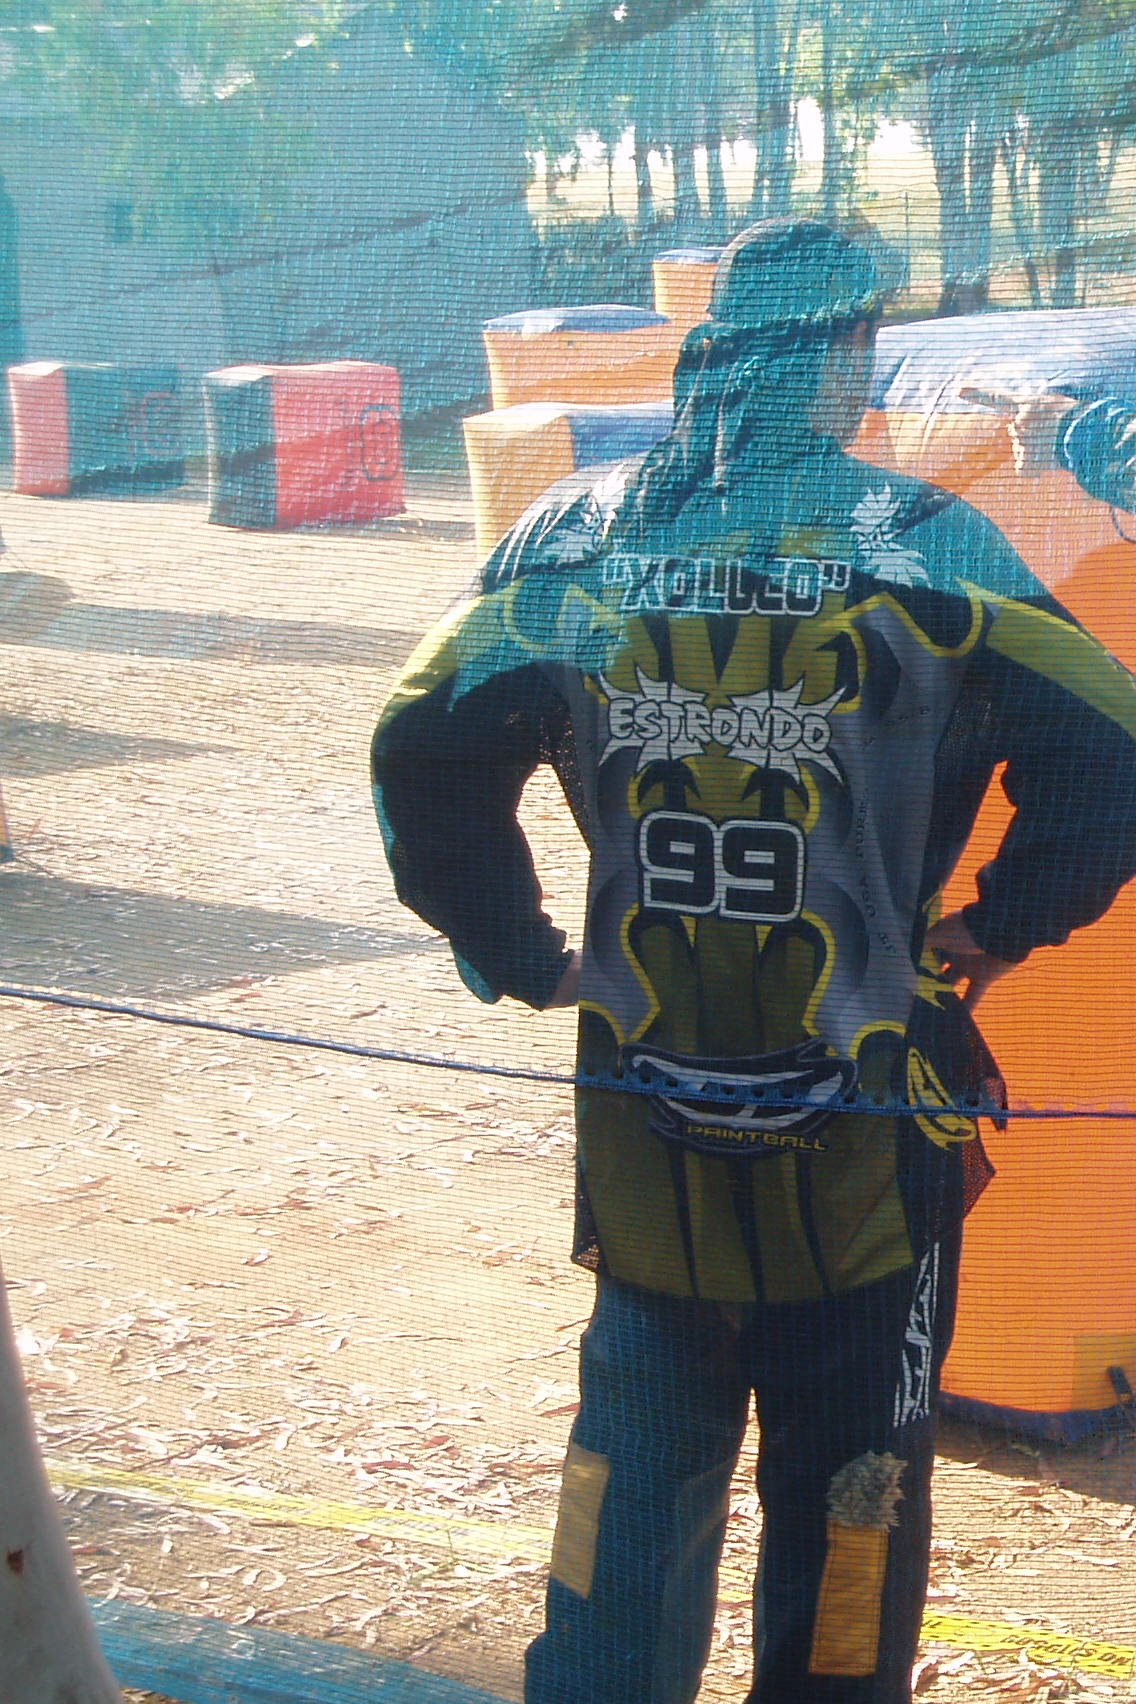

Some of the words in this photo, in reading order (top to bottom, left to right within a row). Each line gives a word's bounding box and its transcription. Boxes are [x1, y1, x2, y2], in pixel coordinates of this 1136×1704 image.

[606, 696, 833, 753] ESTRONDO
[639, 810, 805, 922] 99
[686, 1125, 828, 1151] PAINTBALL
